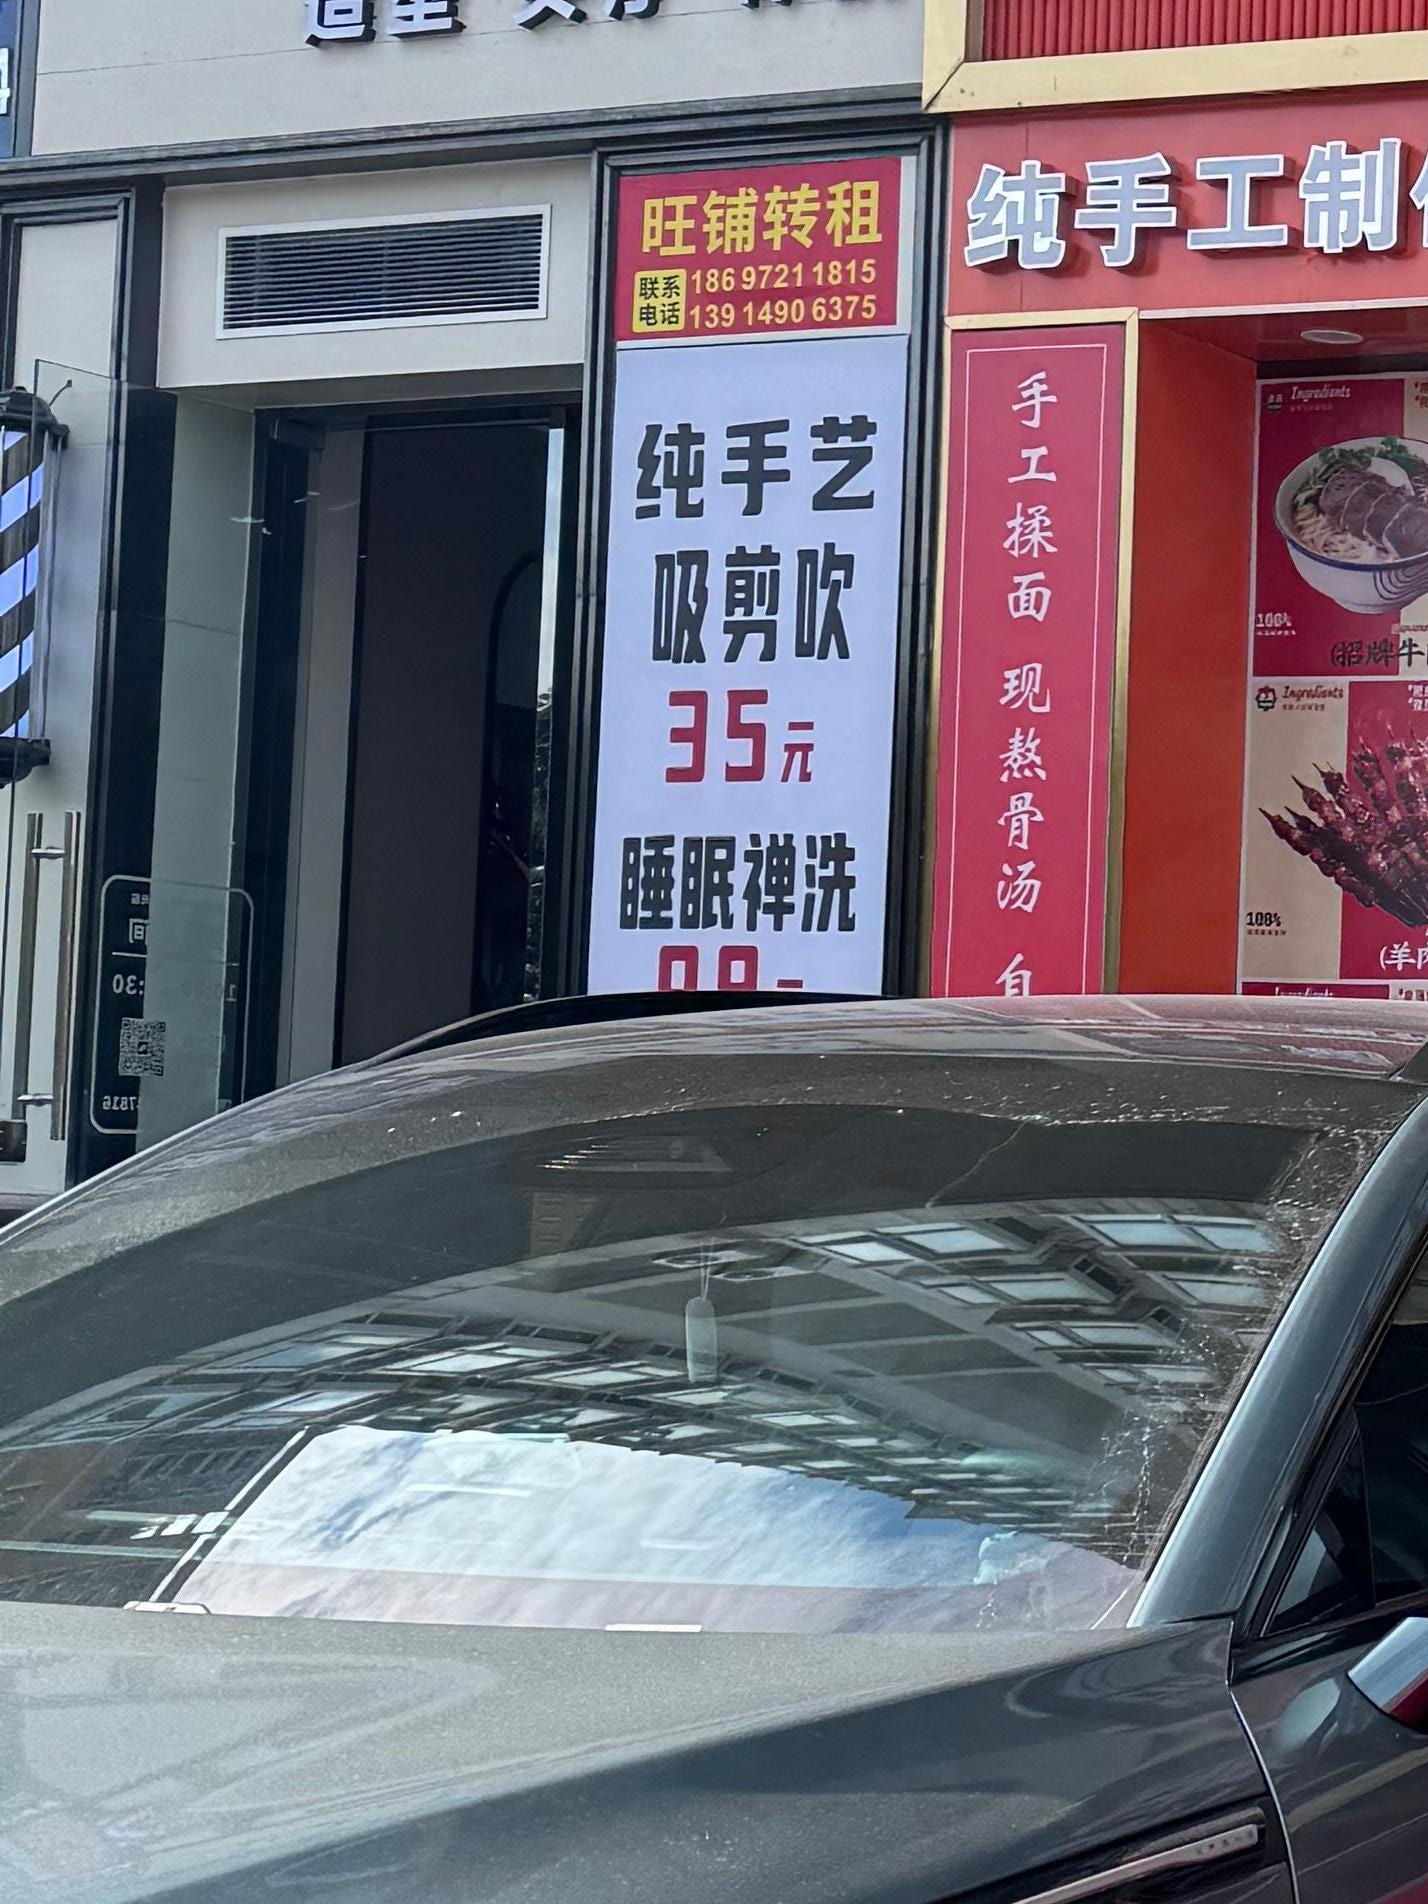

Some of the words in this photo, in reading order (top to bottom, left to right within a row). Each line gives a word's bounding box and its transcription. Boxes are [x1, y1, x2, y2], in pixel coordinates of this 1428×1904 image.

[641, 180, 883, 257] 旺铺转租
[638, 274, 681, 300] 联系
[638, 302, 681, 327] 电话
[634, 414, 878, 521] 纯手艺
[1005, 368, 1058, 624] 手工揉面
[652, 541, 856, 664] 吸剪吹
[996, 661, 1052, 914] 现熬骨汤
[619, 833, 856, 932] 睡眠禅洗
